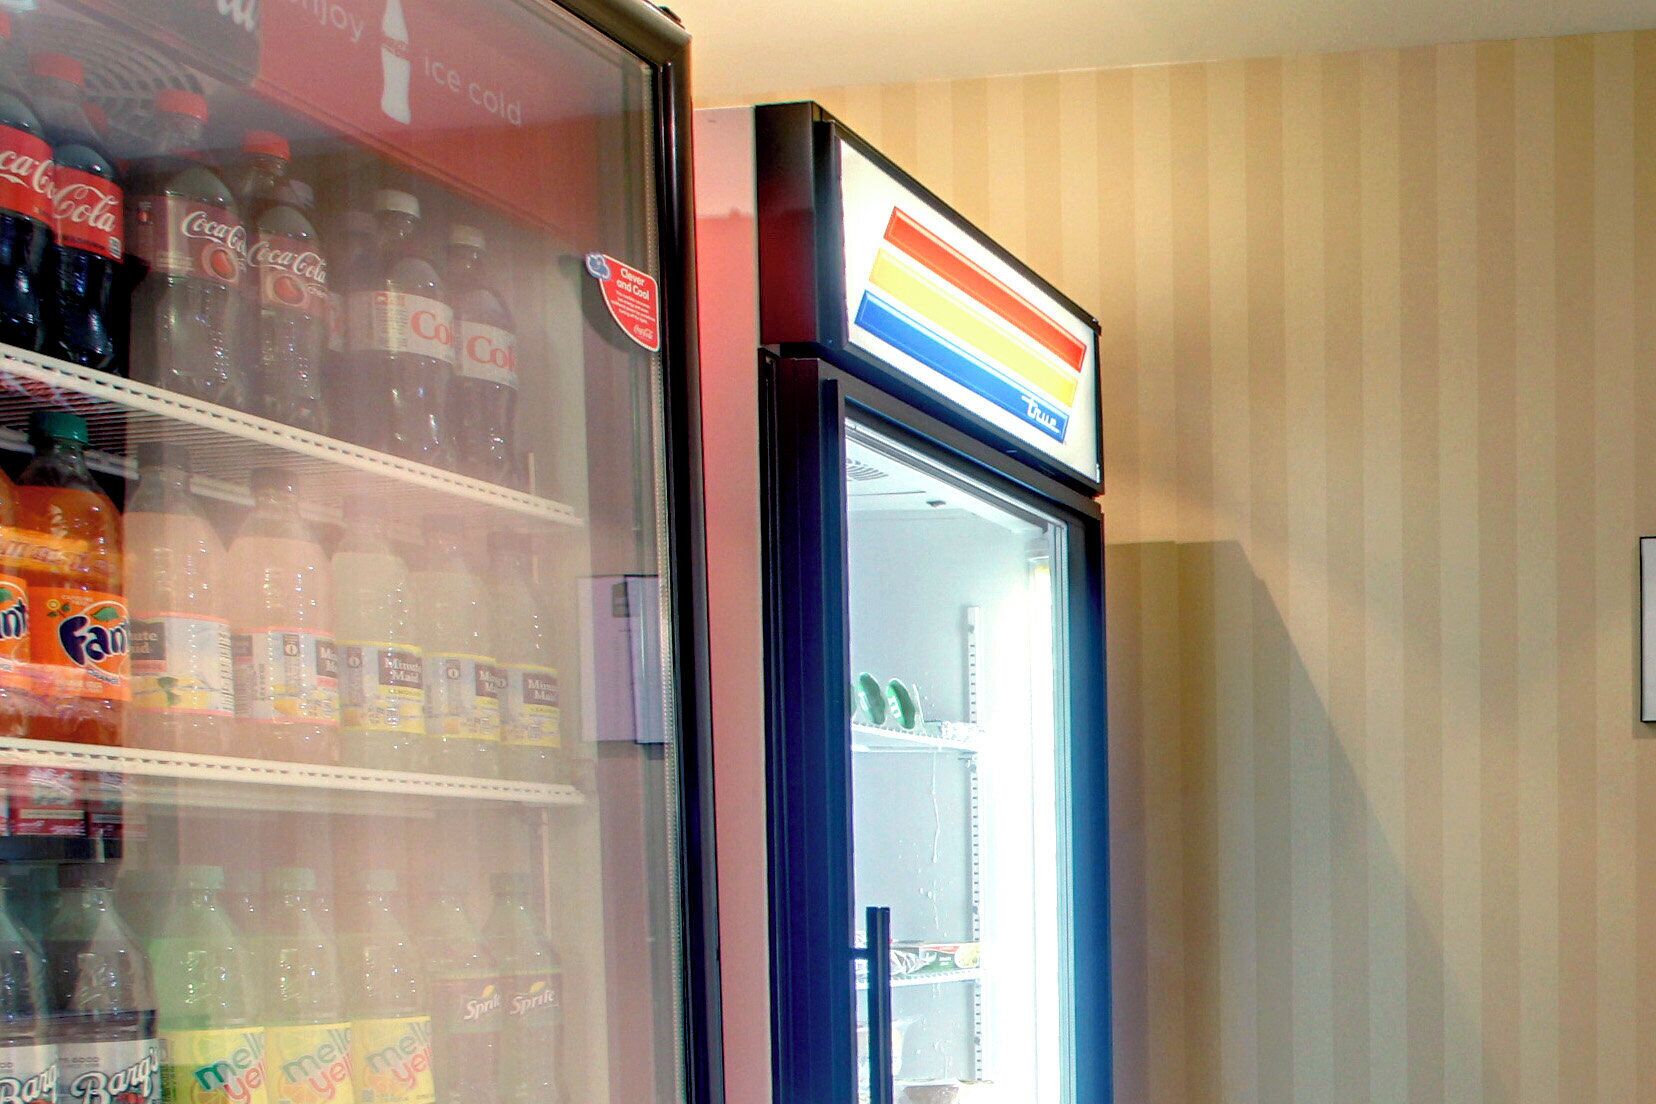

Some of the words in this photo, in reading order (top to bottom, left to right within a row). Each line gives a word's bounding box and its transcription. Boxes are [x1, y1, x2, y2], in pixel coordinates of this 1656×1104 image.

[424, 49, 460, 92] ice
[468, 82, 521, 125] cold
[617, 280, 631, 292] and
[633, 284, 650, 300] Cool
[621, 268, 645, 286] Clever
[1021, 394, 1060, 434] true
